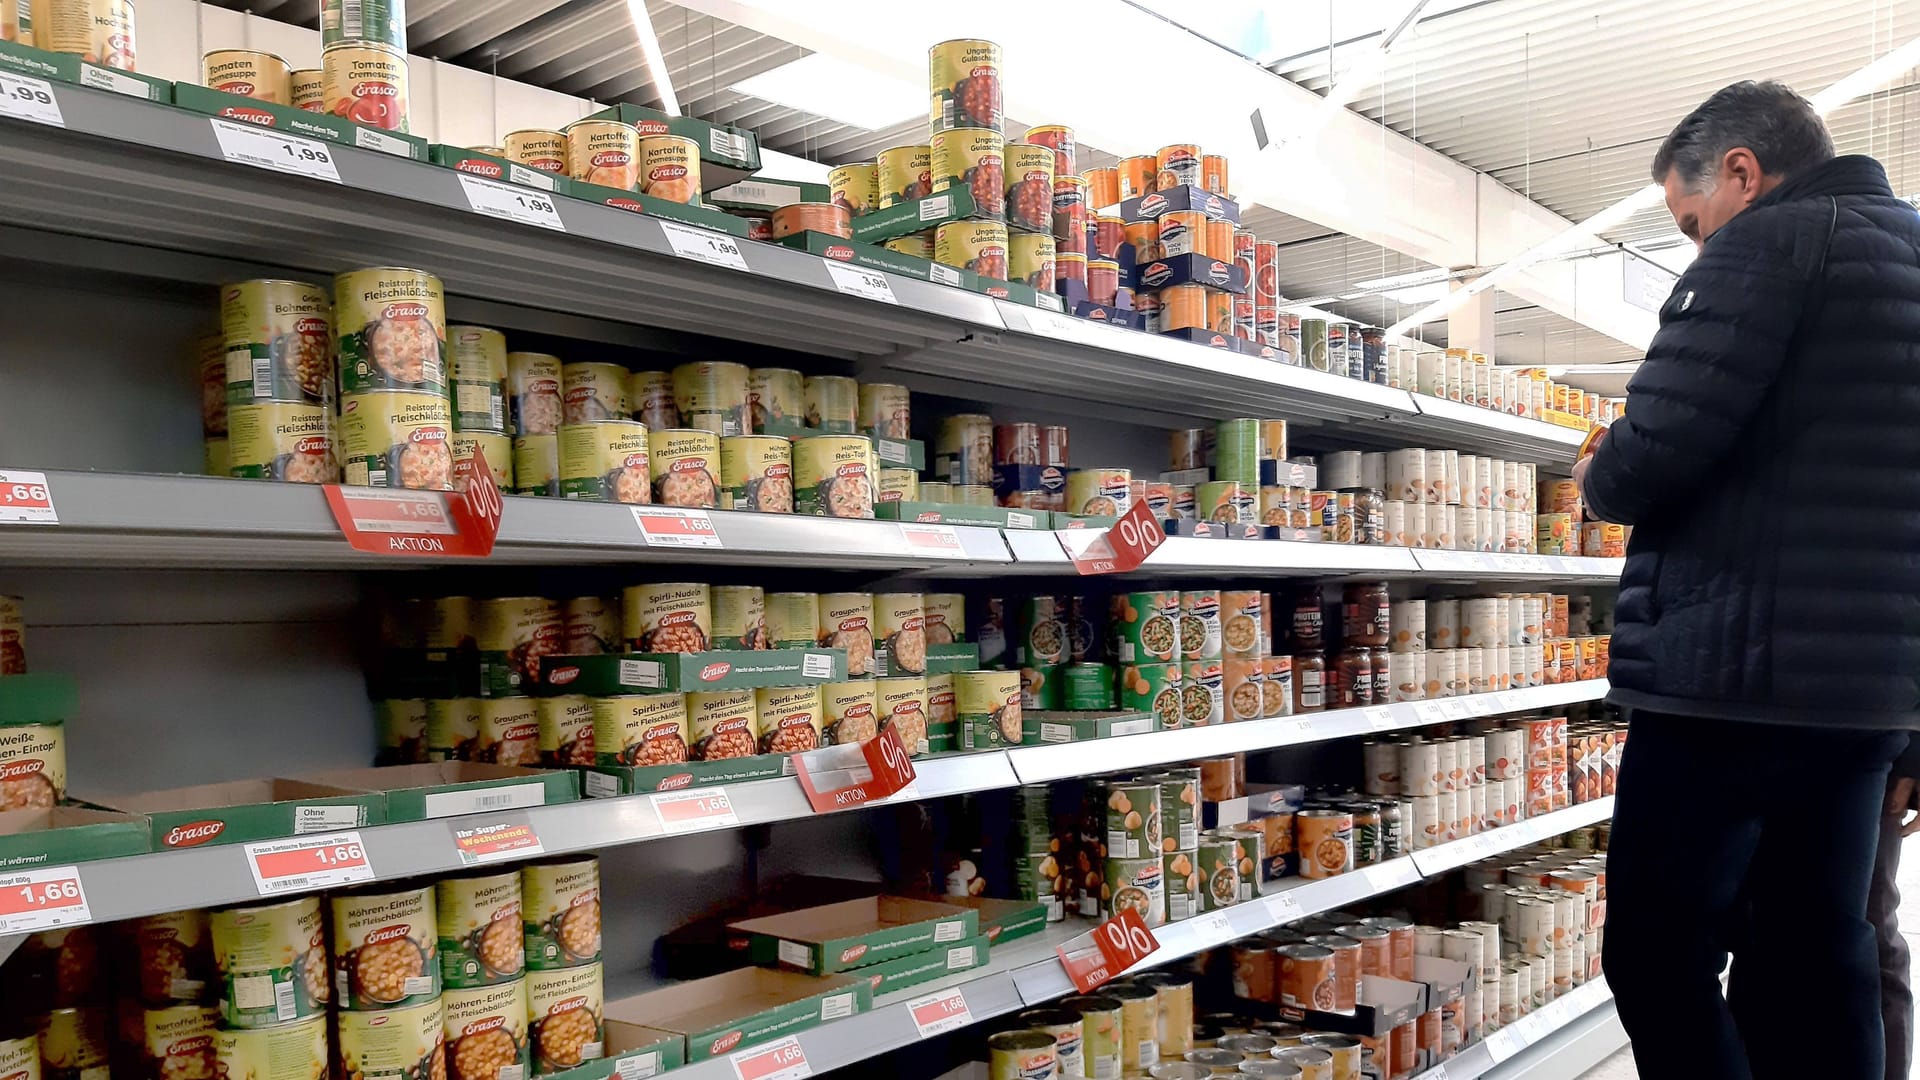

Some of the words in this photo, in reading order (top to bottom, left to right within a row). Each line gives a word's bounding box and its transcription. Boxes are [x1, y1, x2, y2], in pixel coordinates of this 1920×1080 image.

[209, 60, 252, 75] Tomaten
[352, 60, 397, 70] Tomaten
[208, 70, 256, 85] Cremesuppe
[355, 82, 398, 96] Erasco
[225, 107, 274, 125] Erasco
[291, 120, 313, 131] Macht
[313, 124, 326, 134] den
[326, 127, 339, 138] Tag
[635, 120, 669, 133] Erasco
[590, 131, 629, 142] Kartoffel
[522, 140, 562, 150] Kartoffel
[588, 140, 632, 151] Cremesuppe
[648, 145, 686, 157] Kartoffel
[282, 144, 329, 164] 1,99
[520, 150, 565, 160] Cremesuppe
[593, 151, 630, 164] Erasco
[645, 155, 689, 166] Cremesuppe
[459, 159, 500, 176] Erasco
[651, 166, 687, 180] Erasco
[516, 196, 554, 214] 1,99
[708, 240, 738, 256] 1,99
[826, 246, 854, 258] Erasco
[379, 278, 415, 289] Reistopf
[415, 278, 428, 288] mit
[862, 275, 888, 290] 3,99
[364, 286, 438, 302] Fleischklößchen
[386, 304, 428, 319] Erasco
[530, 380, 557, 394] Erasco
[406, 403, 438, 414] Reistopf
[412, 428, 447, 442] Erasco
[667, 437, 696, 448] Reistopf
[696, 437, 707, 445] mit
[299, 438, 331, 452] Erasco
[656, 442, 715, 458] Fleischklößchen
[835, 451, 867, 461] Reis-Topf
[673, 459, 707, 472] Erasco
[767, 464, 791, 477] Erasco
[838, 464, 867, 477] Erasco
[469, 463, 500, 531] %
[398, 502, 441, 518] 1,66
[679, 518, 712, 532] 1,66
[1119, 510, 1160, 555] %
[389, 536, 444, 551] AKTION
[934, 533, 959, 546] 1,66
[1092, 560, 1115, 571] AKTION
[649, 589, 701, 604] Spirli-Nudeln
[643, 608, 655, 616] mit
[661, 612, 697, 627] Erasco
[1293, 611, 1321, 621] PROTEIN
[841, 618, 867, 630] Erasco
[550, 666, 581, 682] Erasco
[701, 663, 731, 679] Erasco
[769, 691, 816, 707] Spirli-Nudeln
[835, 689, 876, 705] Graupen-Topf
[884, 688, 924, 701] Graupen-Topf
[763, 710, 776, 718] mit
[847, 703, 872, 716] Erasco
[895, 701, 921, 713] Erasco
[560, 719, 573, 728] mit
[626, 720, 640, 729] mit
[697, 714, 710, 723] mit
[716, 719, 747, 733] Erasco
[781, 714, 811, 728] Erasco
[0, 733, 35, 746] Weiße
[505, 726, 539, 739] Erasco
[646, 724, 678, 740] Erasco
[879, 734, 912, 784] %
[0, 760, 43, 779] Erasco
[659, 774, 693, 791] Erasco
[835, 787, 866, 805] AKTION
[697, 797, 728, 812] 1,66
[303, 808, 326, 817] Ohne
[168, 820, 223, 845] Erasco
[456, 830, 474, 839] Ihr
[475, 823, 511, 835] Super-
[462, 828, 529, 847] Wochenende
[253, 846, 272, 855] Erasco
[315, 845, 362, 865] 1,66
[8, 853, 48, 865] wärmer!
[20, 881, 79, 905] 1,66
[555, 885, 569, 895] mit
[348, 894, 424, 919] Möhren-Eintopf
[475, 899, 489, 909] mit
[348, 919, 361, 929] mit
[362, 905, 424, 926] Fleischbällchen
[368, 923, 411, 945] Erasco
[1106, 915, 1151, 960] %
[841, 944, 868, 962] Erasco
[533, 967, 598, 992] Möhren-Eintopf
[1086, 967, 1110, 986] AKTION
[447, 985, 517, 1011] Möhren-Eintopf
[533, 992, 547, 1001] mit
[551, 995, 589, 1015] Erasco
[941, 997, 964, 1013] 1,66
[447, 1011, 461, 1021] mit
[465, 1015, 504, 1036] Erasco
[169, 1035, 213, 1055] Erasco
[712, 1031, 743, 1054] Erasco
[772, 1045, 802, 1065] 1,66
